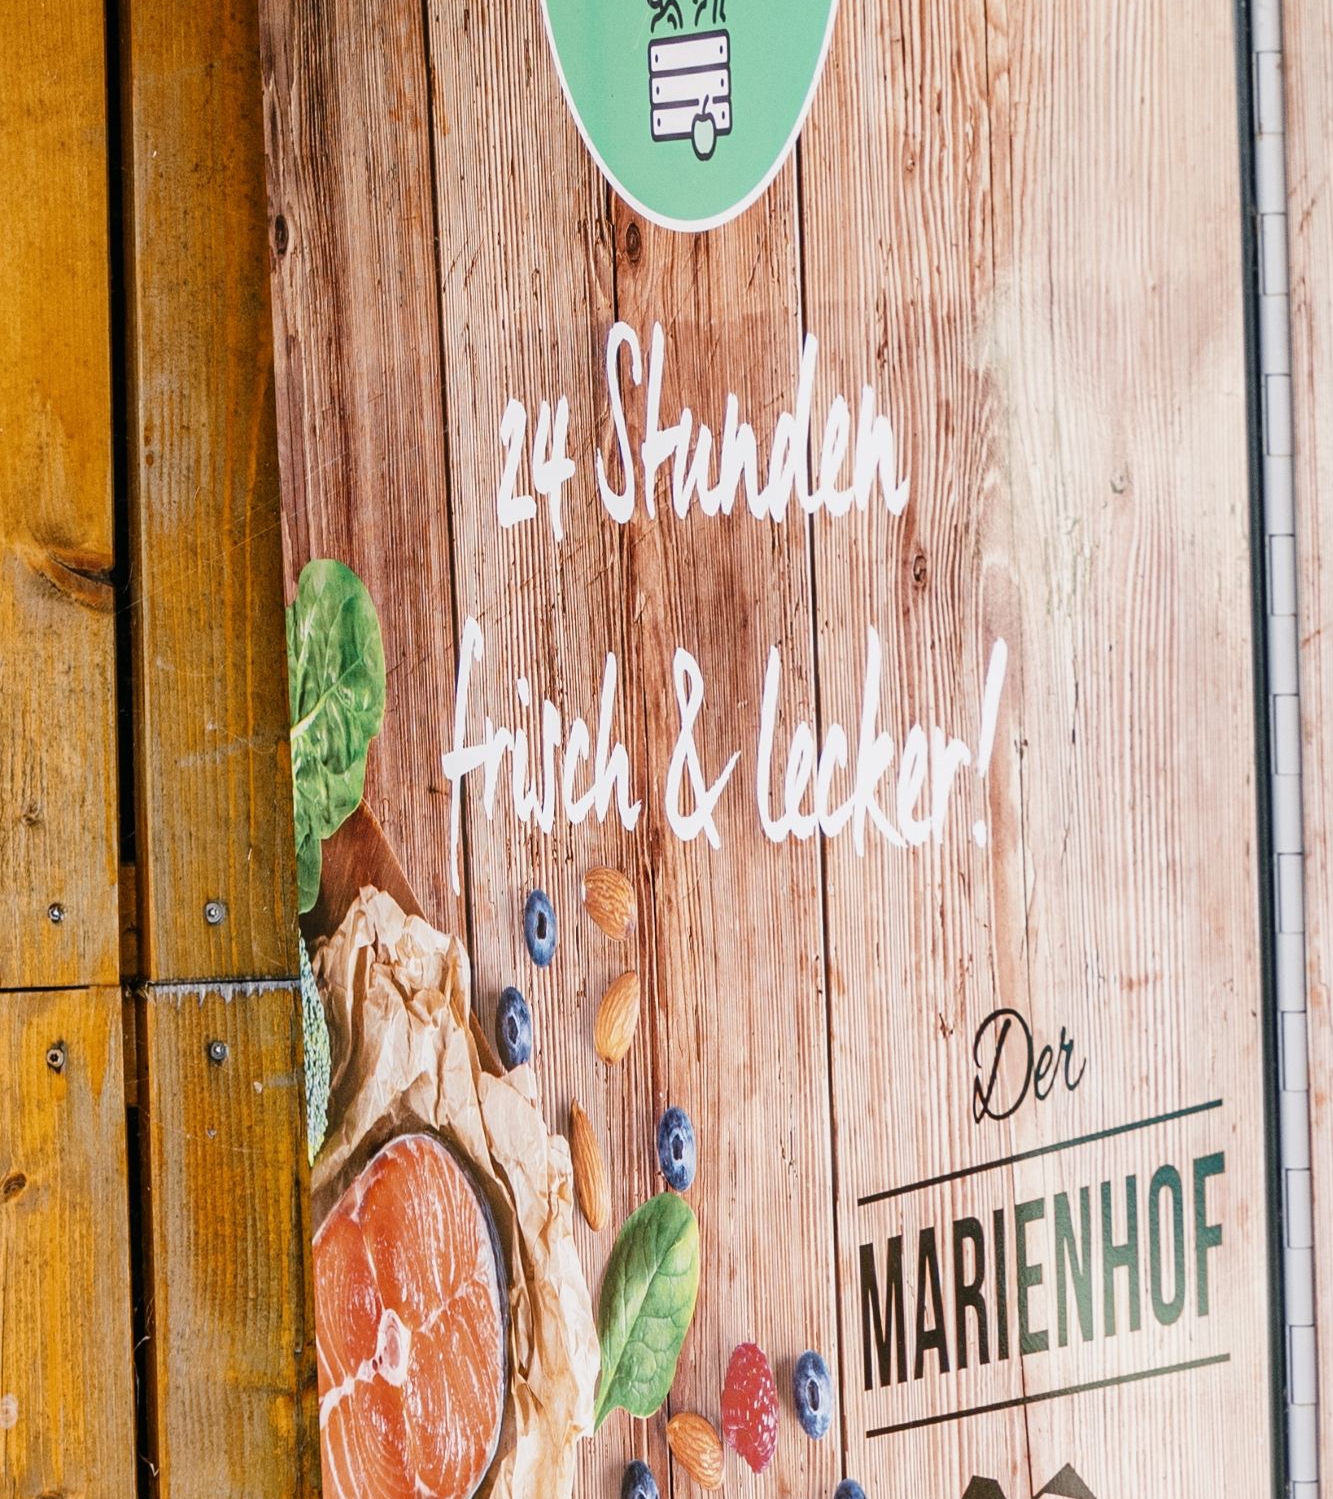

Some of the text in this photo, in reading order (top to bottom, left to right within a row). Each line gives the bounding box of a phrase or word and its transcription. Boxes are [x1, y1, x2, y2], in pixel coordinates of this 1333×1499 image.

[497, 321, 909, 541] 24 Stunden
[441, 615, 1007, 896] frisch & lecker!
[972, 1007, 1086, 1124] Der
[859, 1151, 1225, 1391] MARIENHOF
